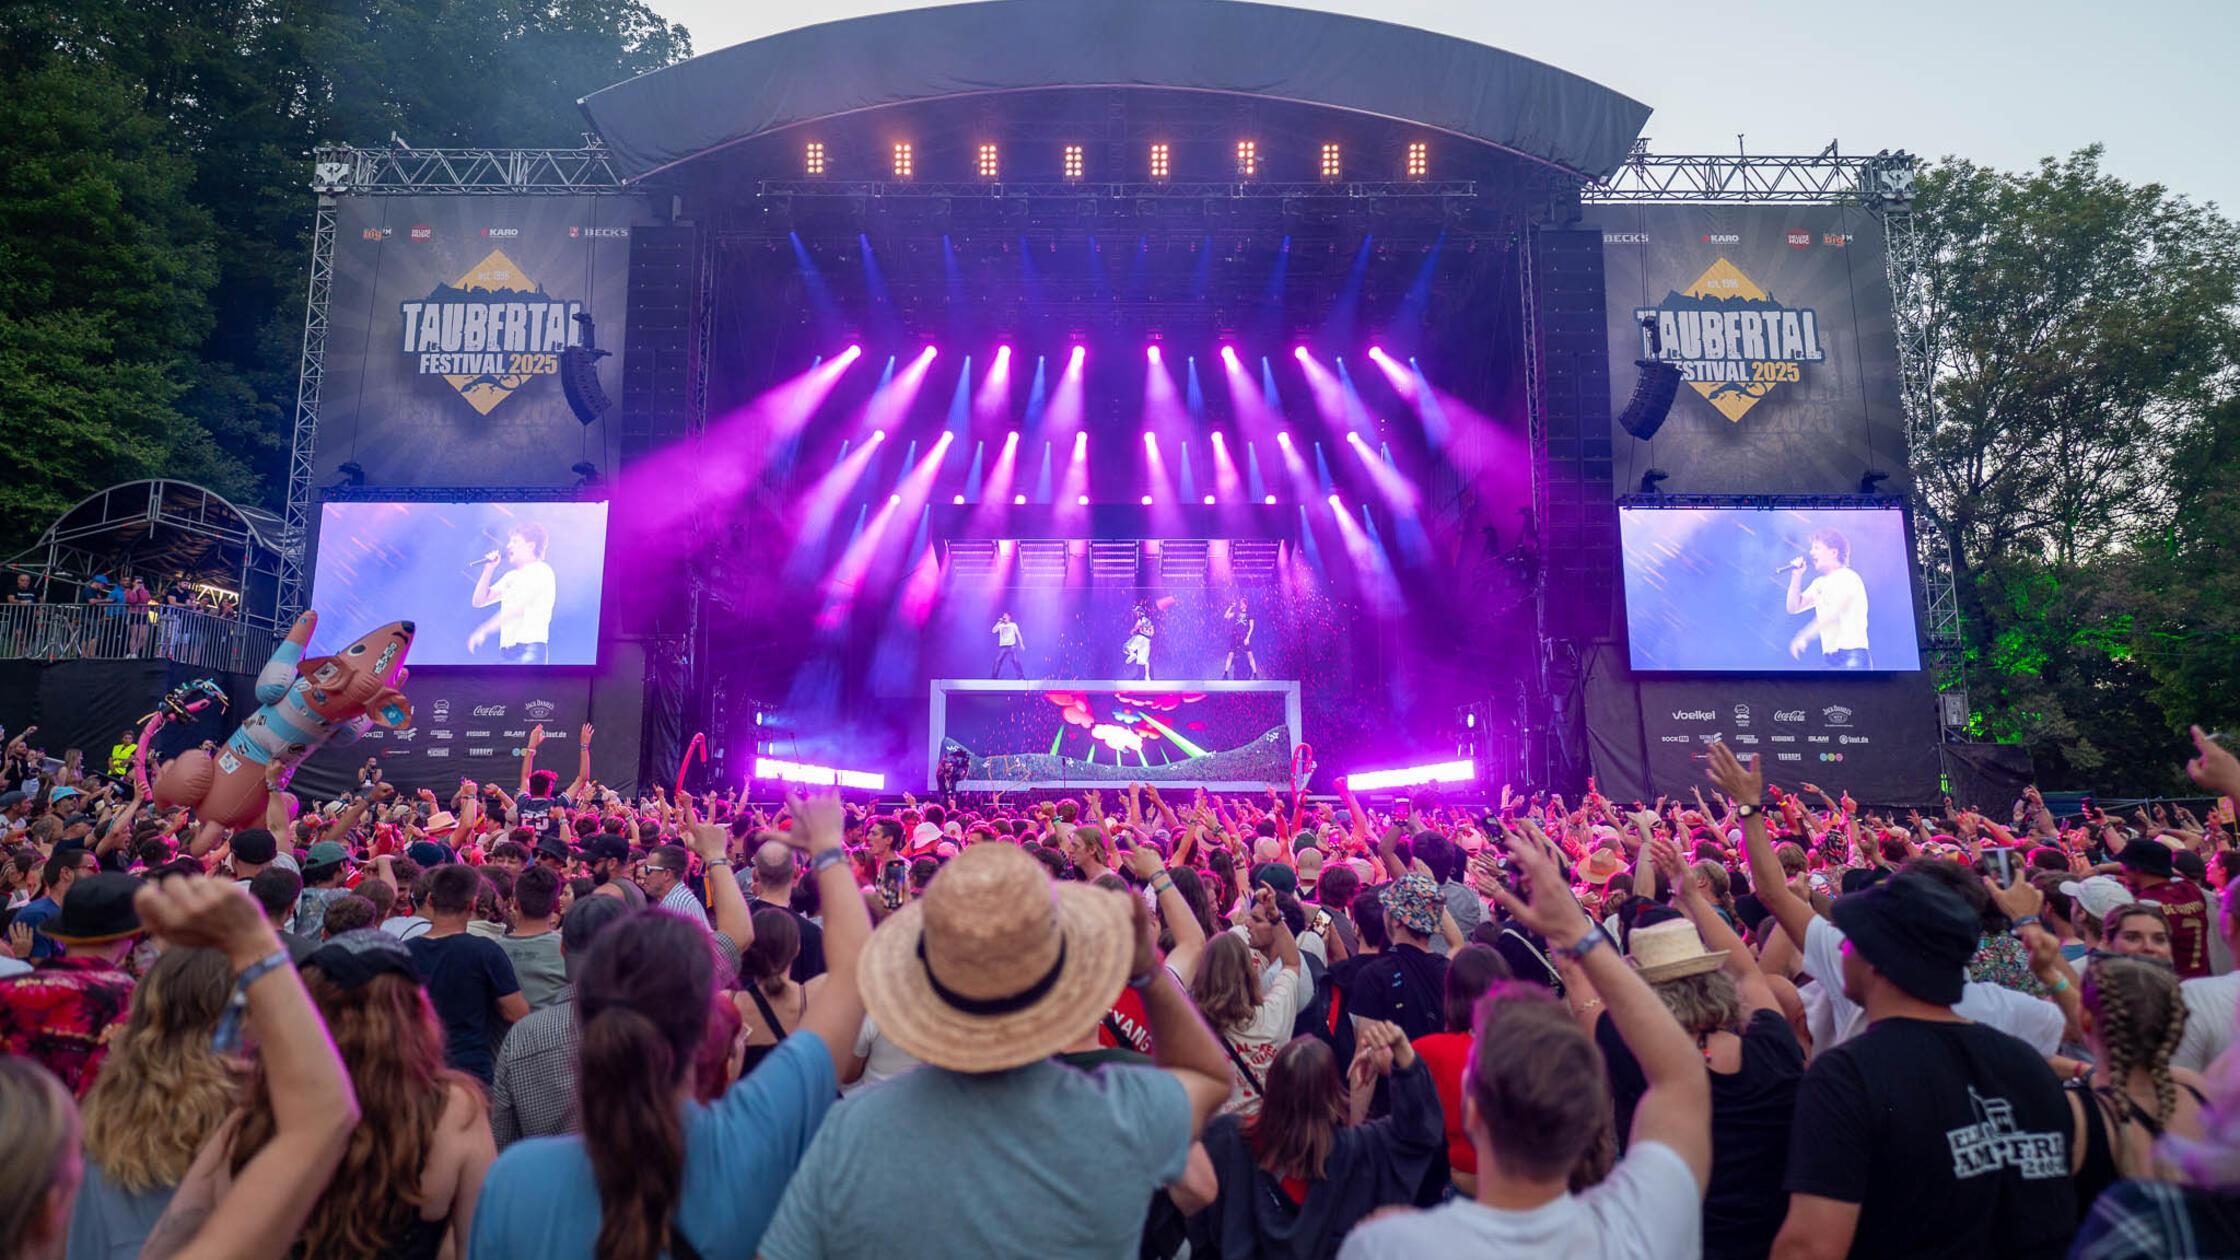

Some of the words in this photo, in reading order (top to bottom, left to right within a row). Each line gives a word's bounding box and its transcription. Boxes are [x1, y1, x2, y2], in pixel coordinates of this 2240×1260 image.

[489, 228, 518, 237] KARO
[1711, 234, 1739, 243] KARO
[403, 303, 582, 352] TAUBERTAL
[1638, 311, 1822, 360] TAUBERTAL
[420, 355, 504, 374] FESTIVAL
[508, 354, 558, 374] 2025
[1664, 361, 1749, 382] ESTIVAL
[1752, 361, 1800, 382] 2025
[1672, 709, 1716, 721] Voelkel
[2181, 917, 2202, 968] 7
